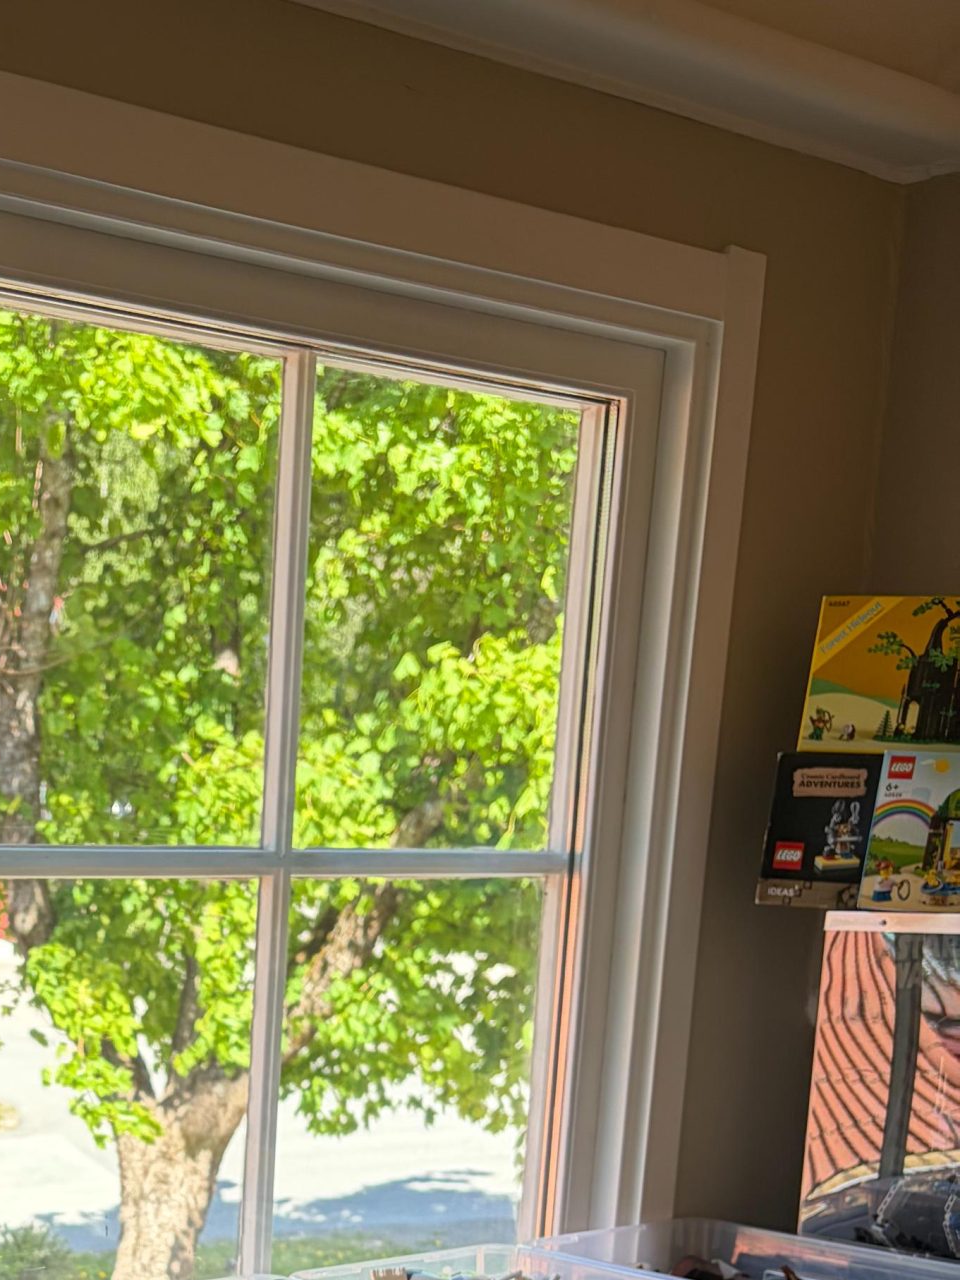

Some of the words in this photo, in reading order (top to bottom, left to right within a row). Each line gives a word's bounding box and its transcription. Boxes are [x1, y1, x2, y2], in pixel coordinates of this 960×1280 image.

[891, 762, 913, 772] LEGO
[799, 780, 861, 789] ADVENTURES
[885, 783, 899, 791] 6+
[776, 849, 800, 862] LEGO
[767, 886, 794, 897] IDEAS
